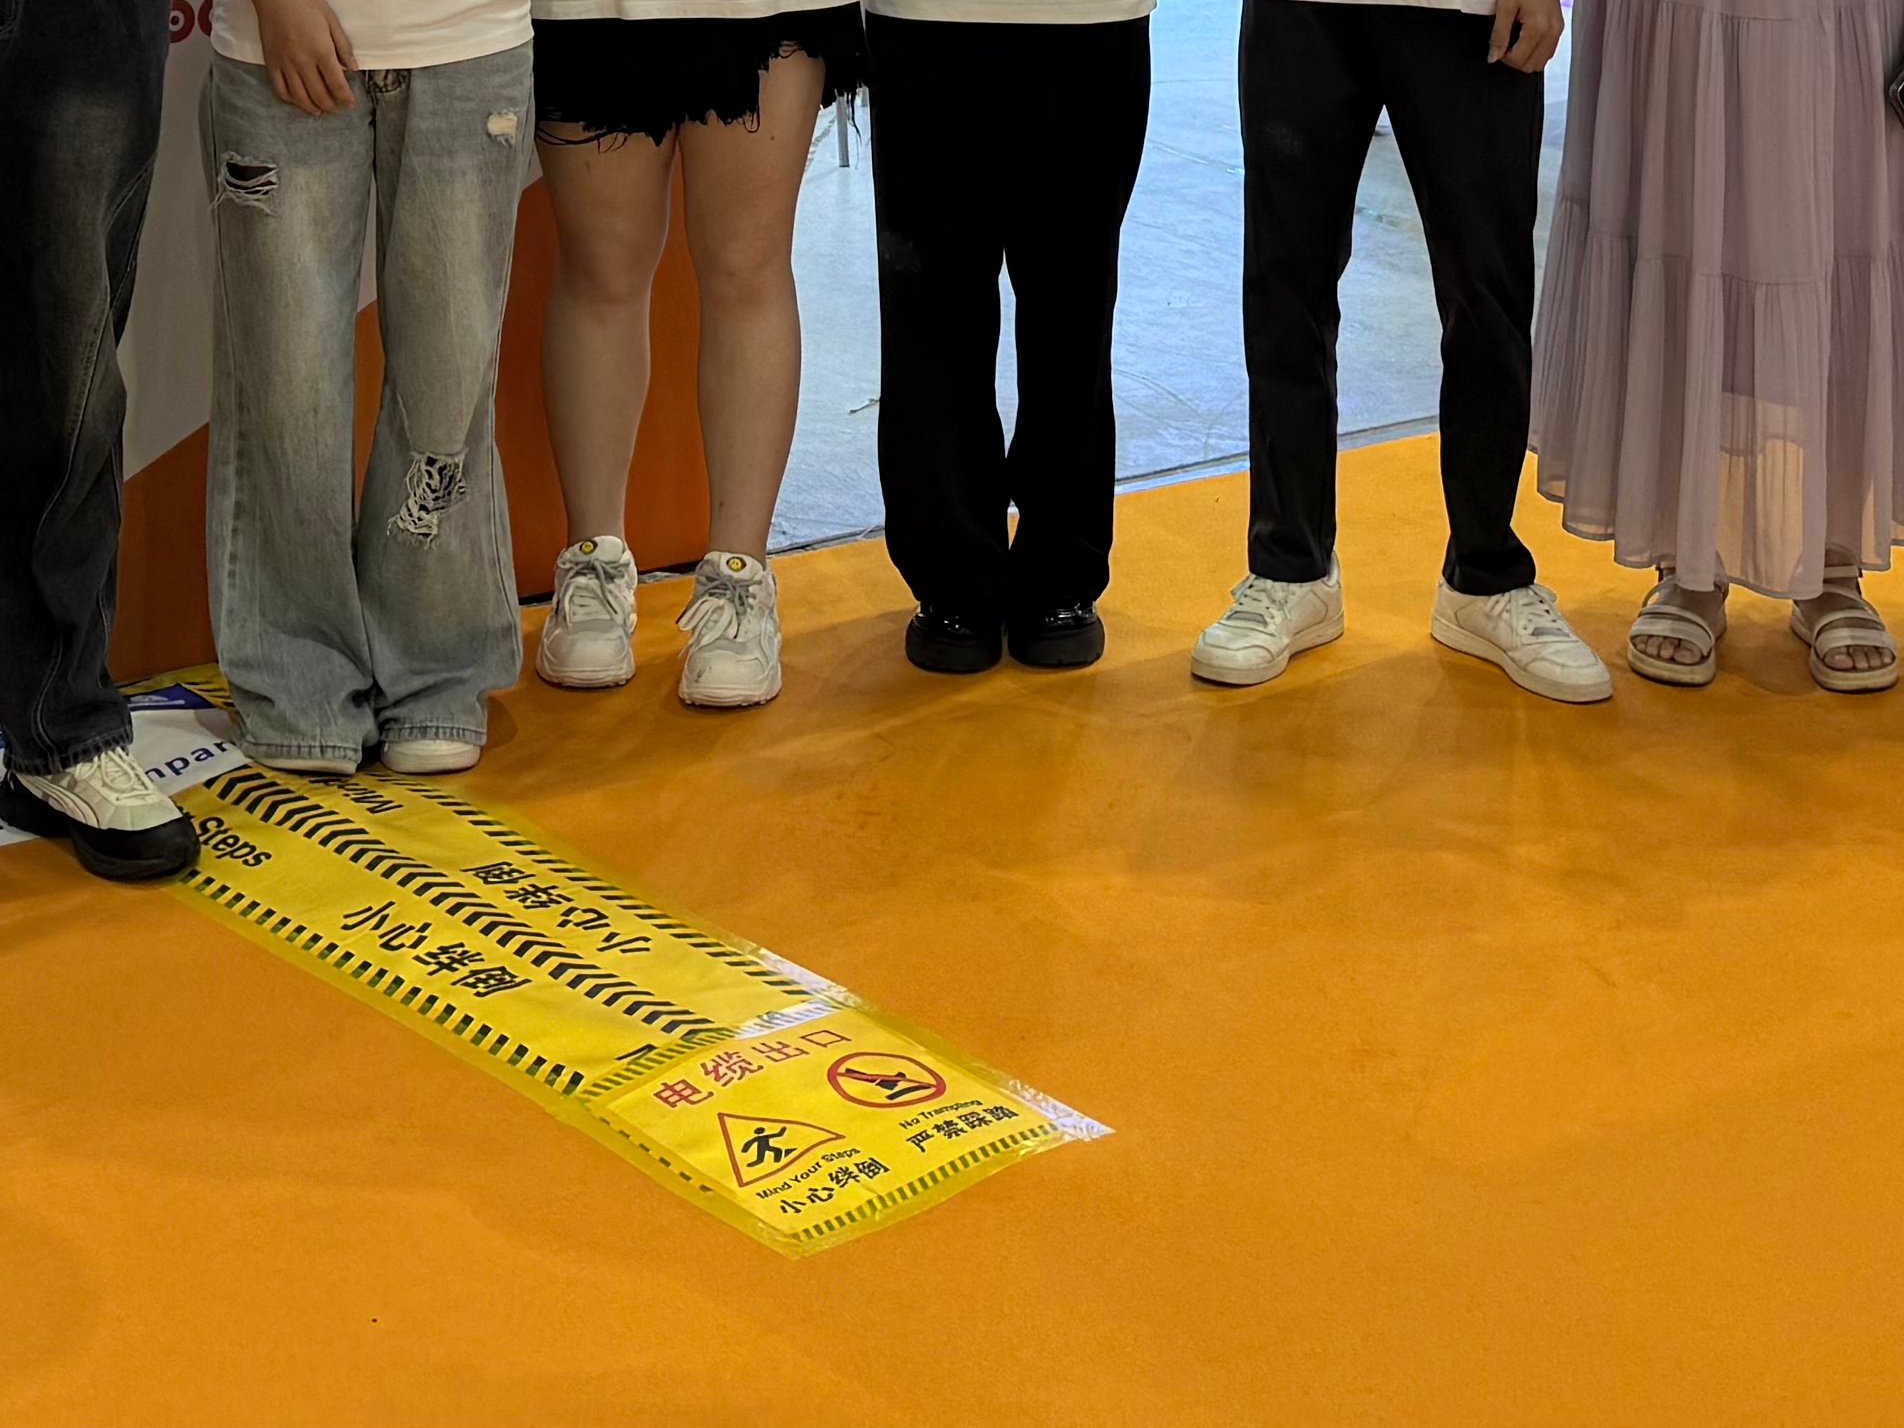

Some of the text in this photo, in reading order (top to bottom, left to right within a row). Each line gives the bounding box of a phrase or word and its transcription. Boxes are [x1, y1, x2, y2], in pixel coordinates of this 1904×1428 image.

[143, 739, 229, 780] npar
[197, 814, 274, 870] Steps
[342, 899, 533, 999] 小心绊倒
[651, 1026, 853, 1111] 电缆出口
[898, 1097, 985, 1130] No Trampling
[904, 1102, 1020, 1154] 严禁踩踏
[754, 1145, 862, 1201] Mind Your Steps
[777, 1156, 892, 1216] 小心绊倒
